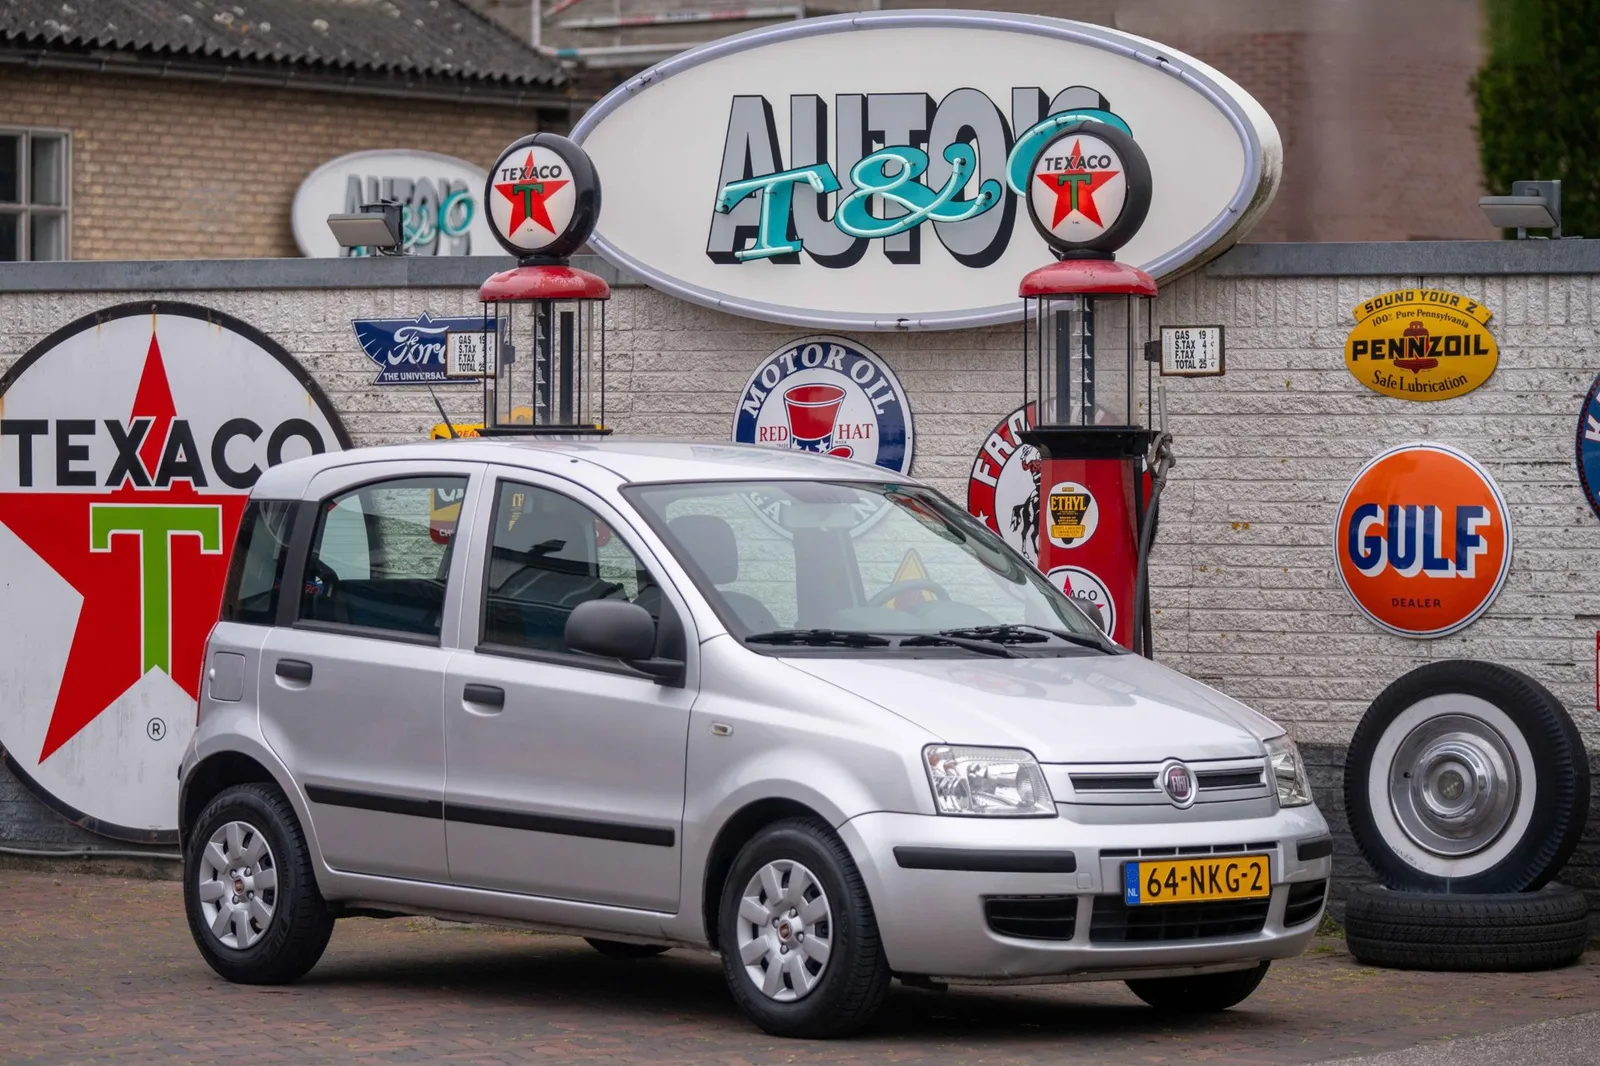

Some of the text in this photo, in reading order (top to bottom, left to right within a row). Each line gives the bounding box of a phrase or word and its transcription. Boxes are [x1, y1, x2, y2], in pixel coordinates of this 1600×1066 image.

[1045, 155, 1111, 171] TEXACO
[502, 165, 562, 181] TEXACO
[1365, 291, 1478, 315] SOUND YOUR Z
[1396, 309, 1415, 319] Pure
[1417, 309, 1469, 329] Pennsylvania
[458, 335, 472, 344] GAS
[1175, 330, 1190, 340] GAS
[1199, 330, 1207, 340] 19
[458, 344, 477, 353] S.TAX
[1175, 340, 1195, 349] S.TAX
[1202, 340, 1207, 349] 4
[1352, 334, 1489, 361] PENNZOIL
[458, 354, 475, 362] F.TAX
[1175, 350, 1195, 359] F.TAX
[458, 363, 477, 372] TOTAL
[1175, 360, 1197, 369] TOTAL
[1199, 360, 1207, 369] 25
[384, 372, 399, 381] THE
[400, 371, 447, 381] UNIVERSAL
[742, 343, 896, 419] MOTOR OIL
[1371, 370, 1468, 392] Safe Lubrication
[759, 423, 874, 442] RED HAT
[0, 417, 326, 490] TEXACO
[1051, 495, 1087, 511] ETHYL
[1349, 502, 1491, 579] GULF
[90, 503, 223, 676] T
[1391, 597, 1442, 609] DEALER
[1171, 775, 1188, 792] FIAT
[1147, 861, 1263, 897] 64-NKG-2
[1127, 887, 1139, 897] NL
